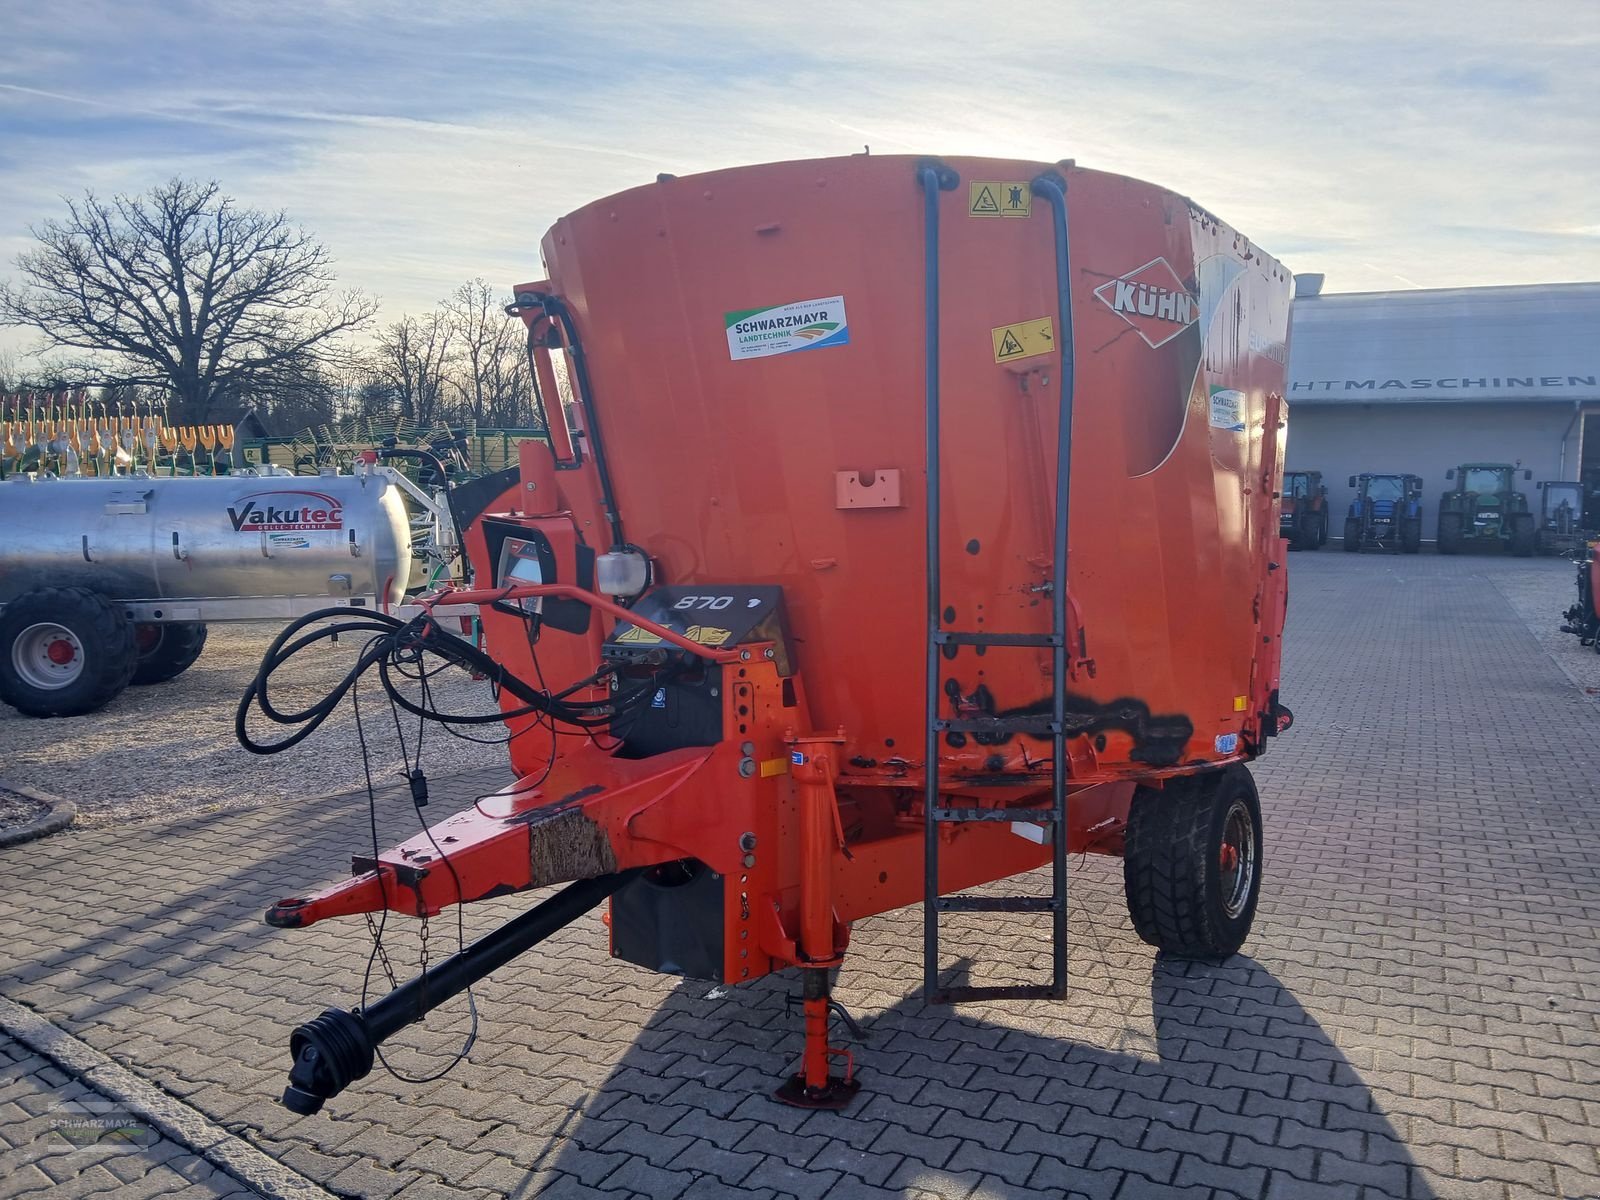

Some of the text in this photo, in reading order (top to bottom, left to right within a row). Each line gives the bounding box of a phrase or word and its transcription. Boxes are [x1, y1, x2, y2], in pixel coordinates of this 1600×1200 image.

[735, 311, 828, 334] SCHWARZMAYR
[739, 330, 792, 344] LANDTECHNIK
[227, 502, 342, 531] Vakutec
[673, 595, 734, 610] 870
